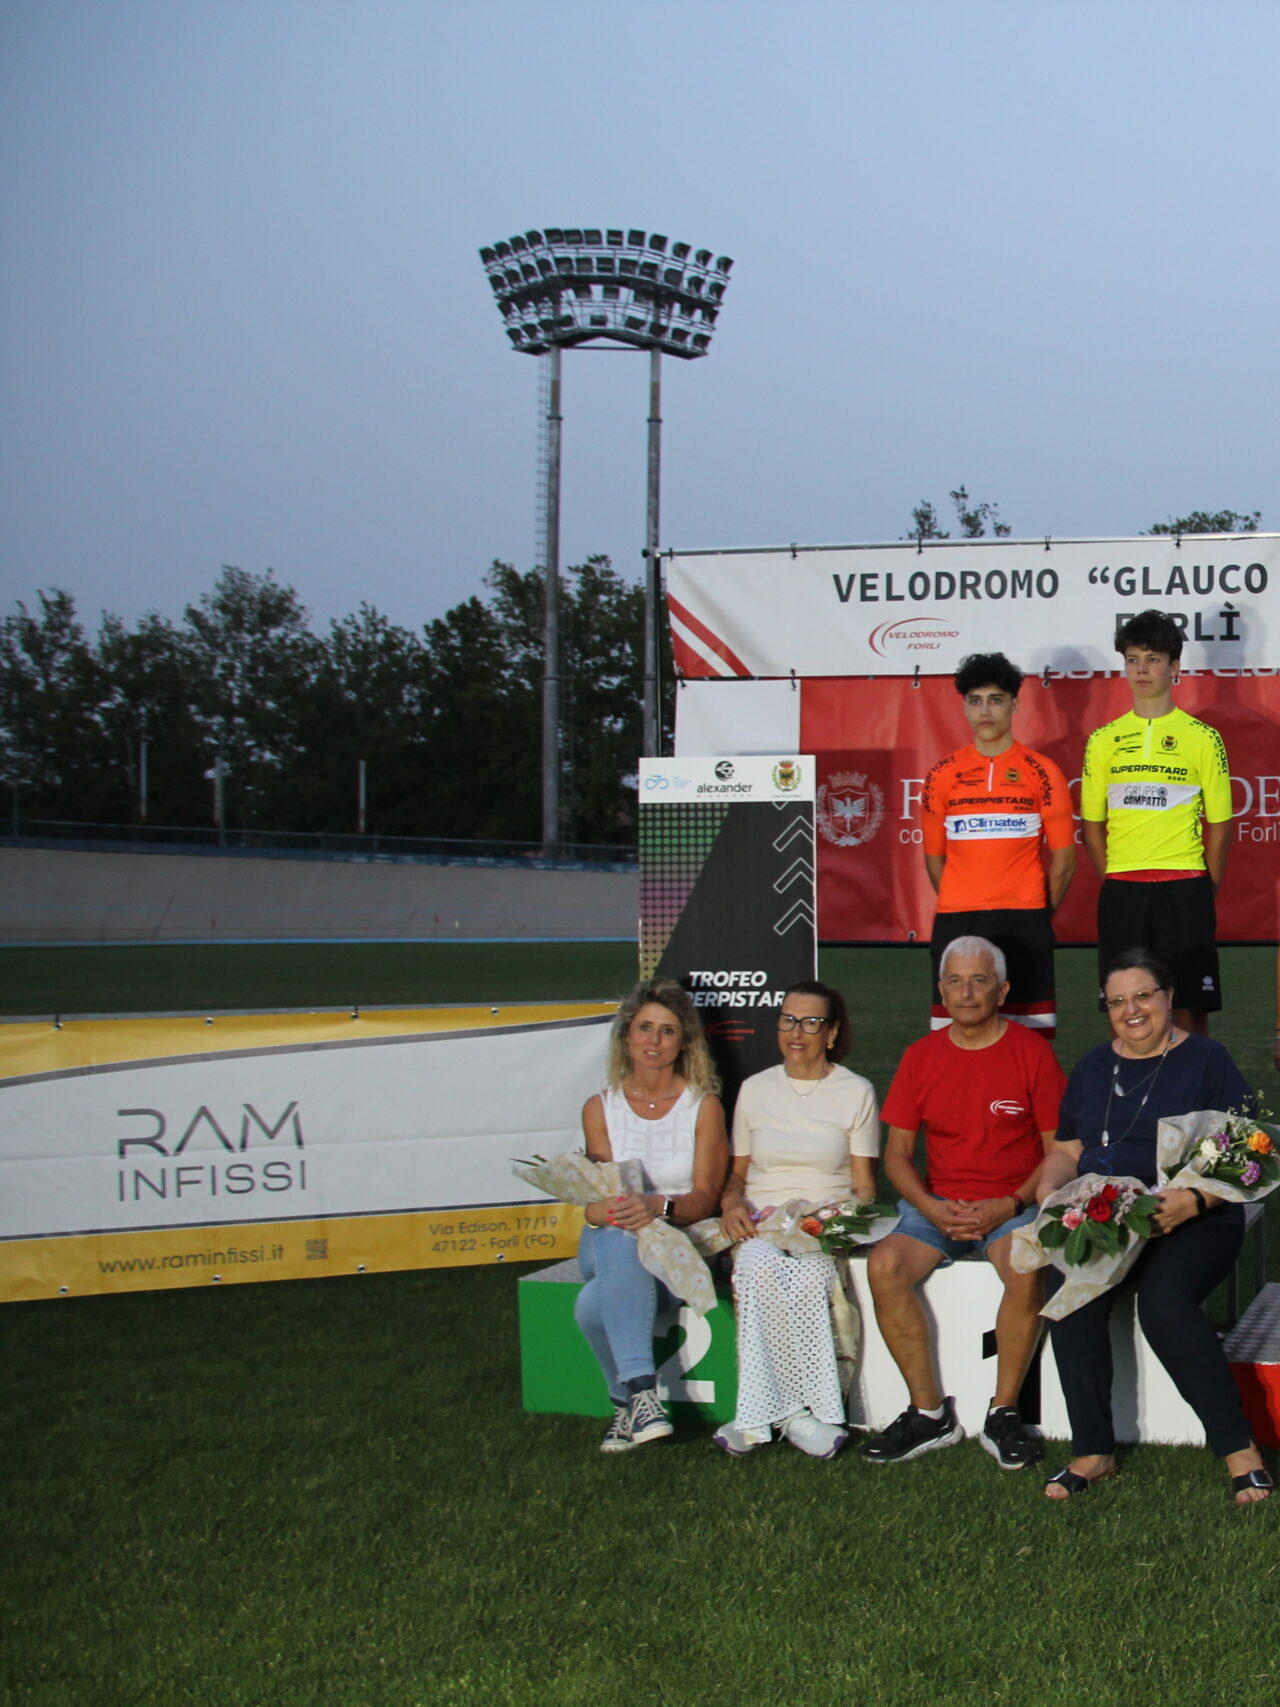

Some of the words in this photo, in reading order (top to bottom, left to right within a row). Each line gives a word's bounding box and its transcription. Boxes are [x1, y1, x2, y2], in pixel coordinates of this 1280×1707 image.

[832, 568, 1059, 603] VELODROMO
[1115, 601, 1240, 643] FRLÌ
[889, 630, 960, 639] VELODROMO
[1110, 764, 1188, 776] SUPERPISTARD
[697, 782, 753, 793] alexander
[948, 796, 1034, 808] SUPERPISTARD
[1123, 796, 1167, 807] COMPATTO
[689, 971, 768, 987] TROFEO
[118, 1101, 305, 1159] RAM
[118, 1160, 306, 1201] INFISSI
[429, 1223, 454, 1236] Via
[432, 1238, 477, 1253] 47122
[524, 1233, 556, 1249] (FC)
[98, 1244, 284, 1274] www.raminfissi.it
[653, 1305, 716, 1403] 2
